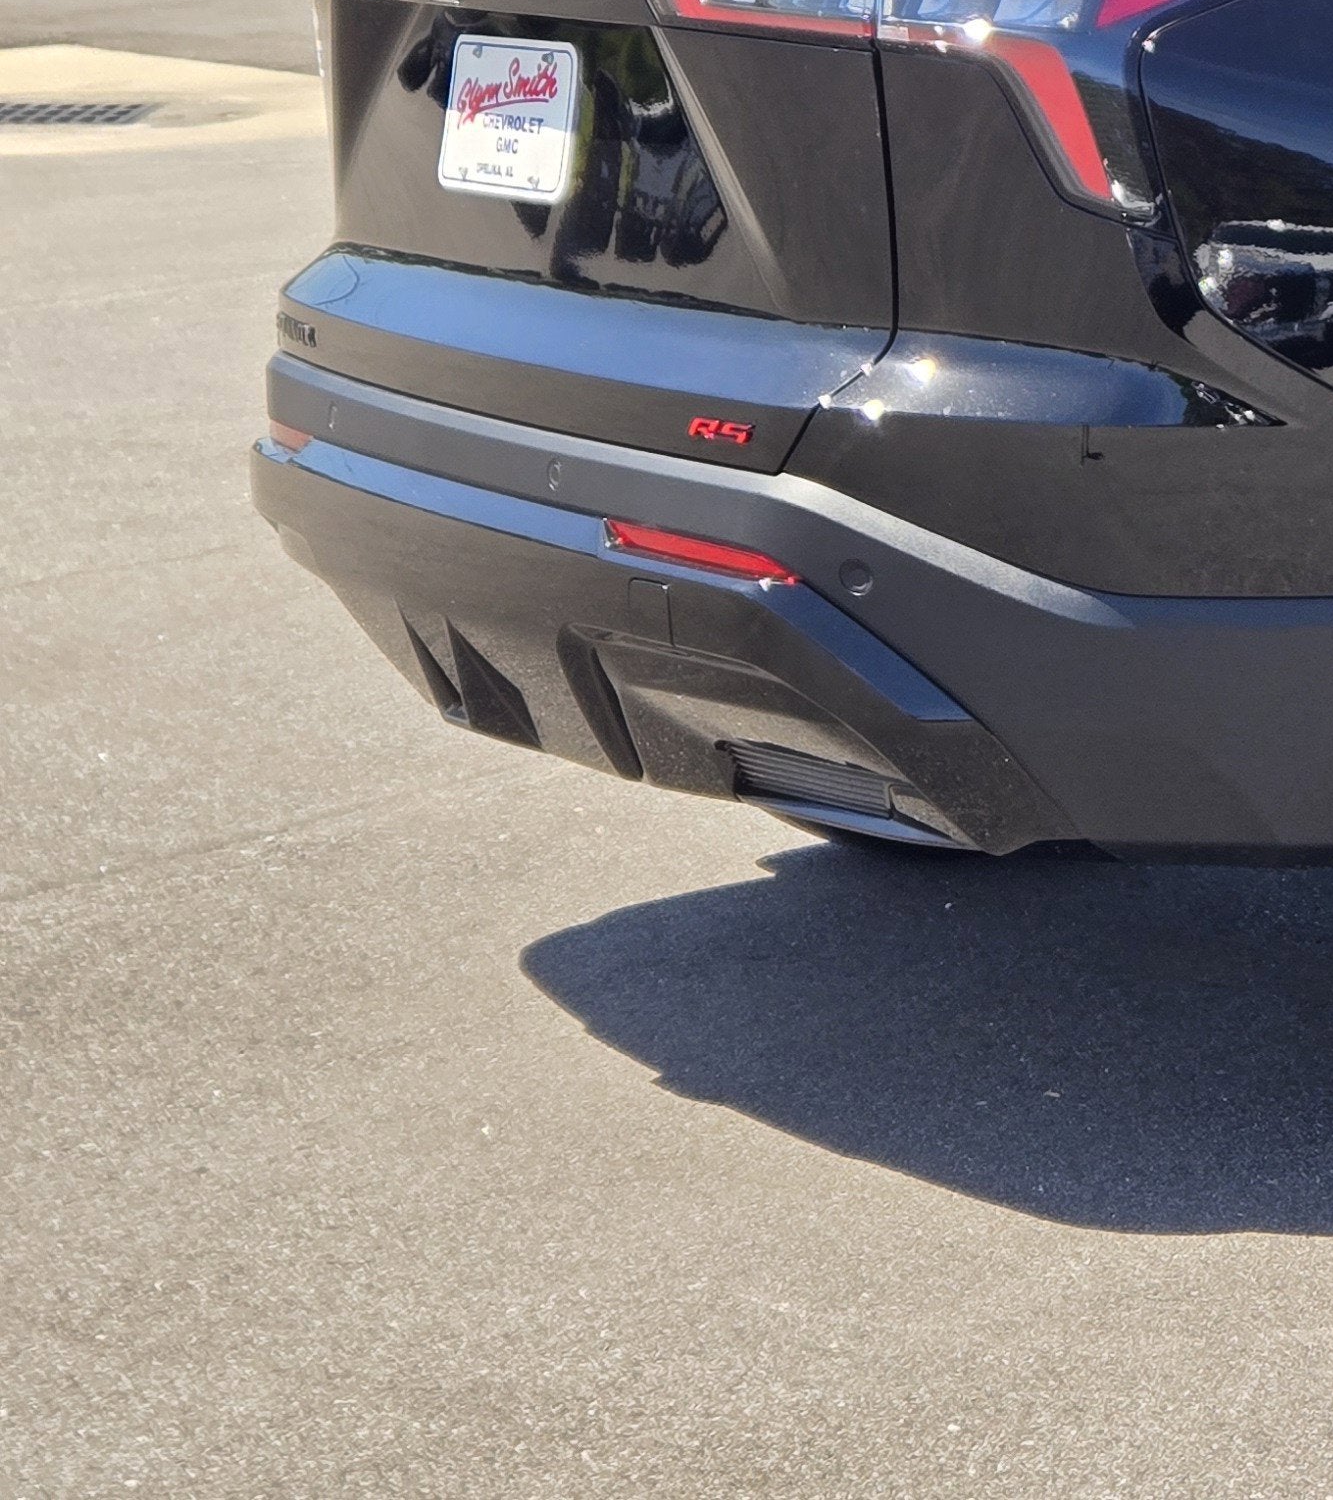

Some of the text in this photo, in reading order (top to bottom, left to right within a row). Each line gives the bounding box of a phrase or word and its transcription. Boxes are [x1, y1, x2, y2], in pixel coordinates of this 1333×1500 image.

[457, 57, 557, 129] Glynn Smith
[482, 112, 544, 135] CHEVROLET
[496, 137, 519, 154] GMC
[688, 416, 755, 444] RS
